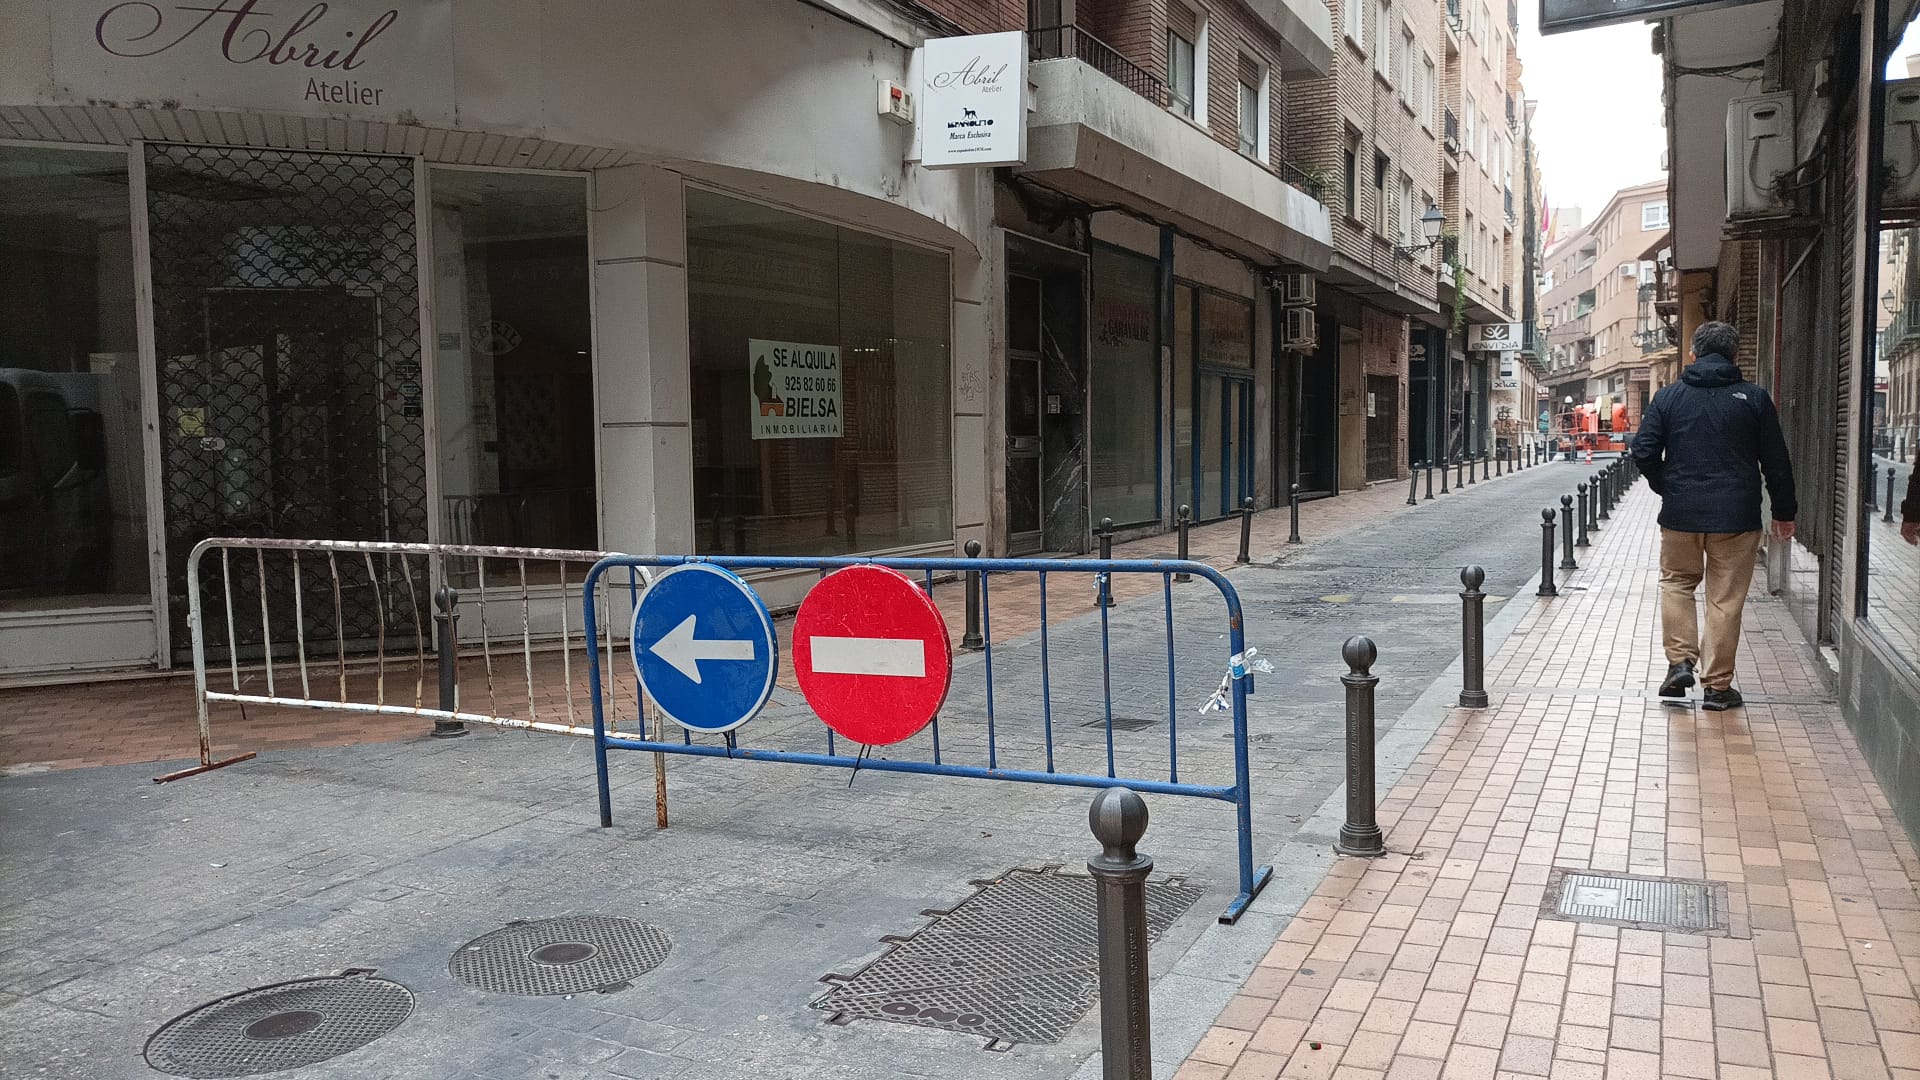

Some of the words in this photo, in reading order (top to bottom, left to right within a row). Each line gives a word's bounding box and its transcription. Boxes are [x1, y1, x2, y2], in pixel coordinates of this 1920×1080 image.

[95, 0, 398, 70] Abril
[933, 56, 1008, 88] Abril
[304, 77, 384, 106] Atelier
[981, 85, 1003, 94] Atelier
[949, 132, 966, 140] Marca
[773, 347, 788, 367] SE
[791, 350, 837, 370] ALQUILA
[785, 376, 801, 391] 925
[803, 376, 813, 392] 82
[815, 377, 825, 392] 60
[827, 378, 836, 392] 66
[785, 397, 837, 418] BIELSA
[760, 424, 838, 434] INMOBILIARIA
